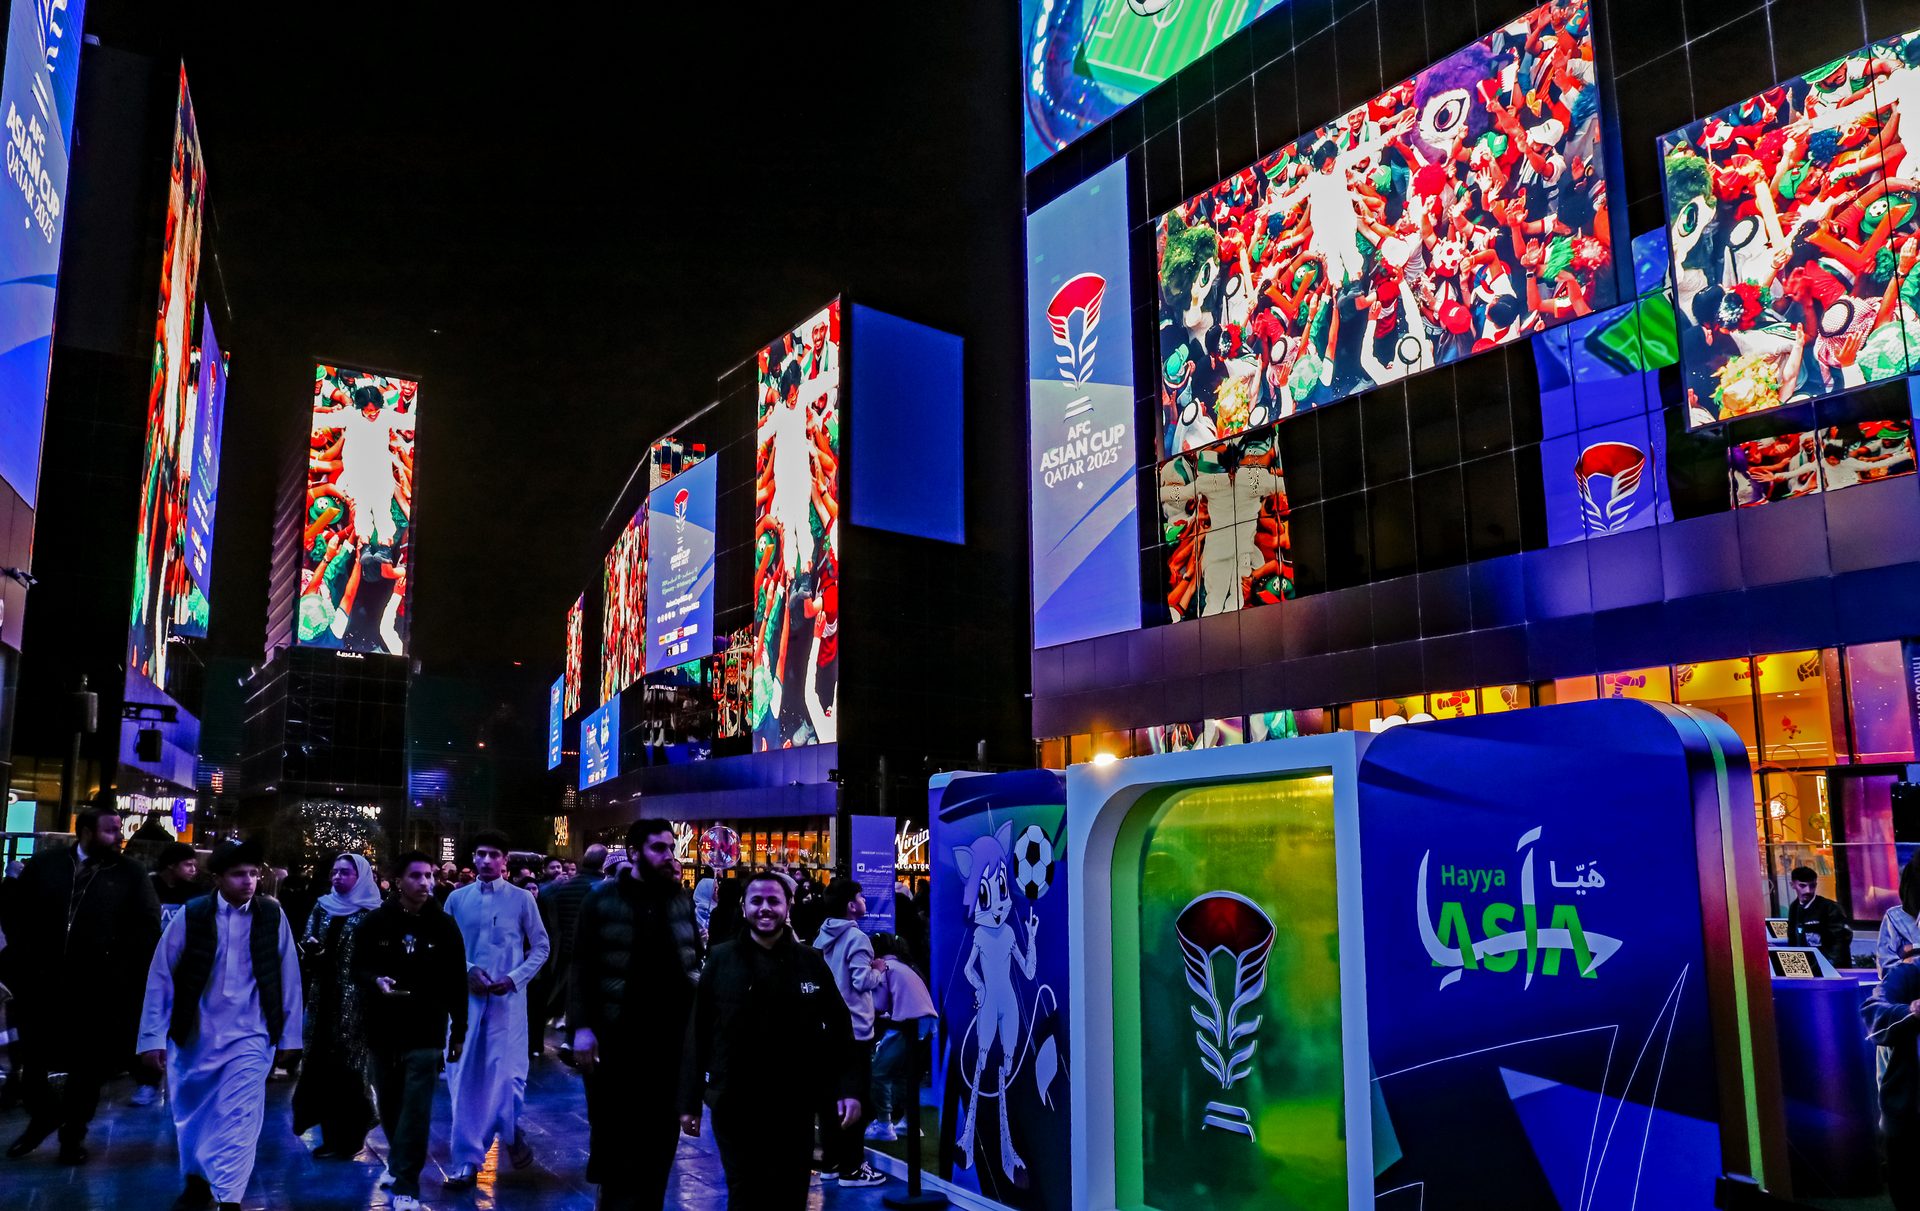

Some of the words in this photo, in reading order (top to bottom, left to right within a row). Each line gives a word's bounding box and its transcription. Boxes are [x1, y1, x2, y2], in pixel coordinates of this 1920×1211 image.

[28, 114, 46, 158] AFC
[6, 101, 41, 187] ASIAN
[39, 169, 60, 220] CUP
[6, 140, 35, 210] QATAR
[1040, 437, 1088, 472] ASIAN
[1089, 423, 1126, 453] CUP
[1067, 420, 1092, 441] AFC
[1044, 460, 1085, 489] QATAR
[894, 819, 930, 862] Virgin
[1441, 864, 1506, 893] Hayya
[1431, 902, 1598, 979] ASIA
